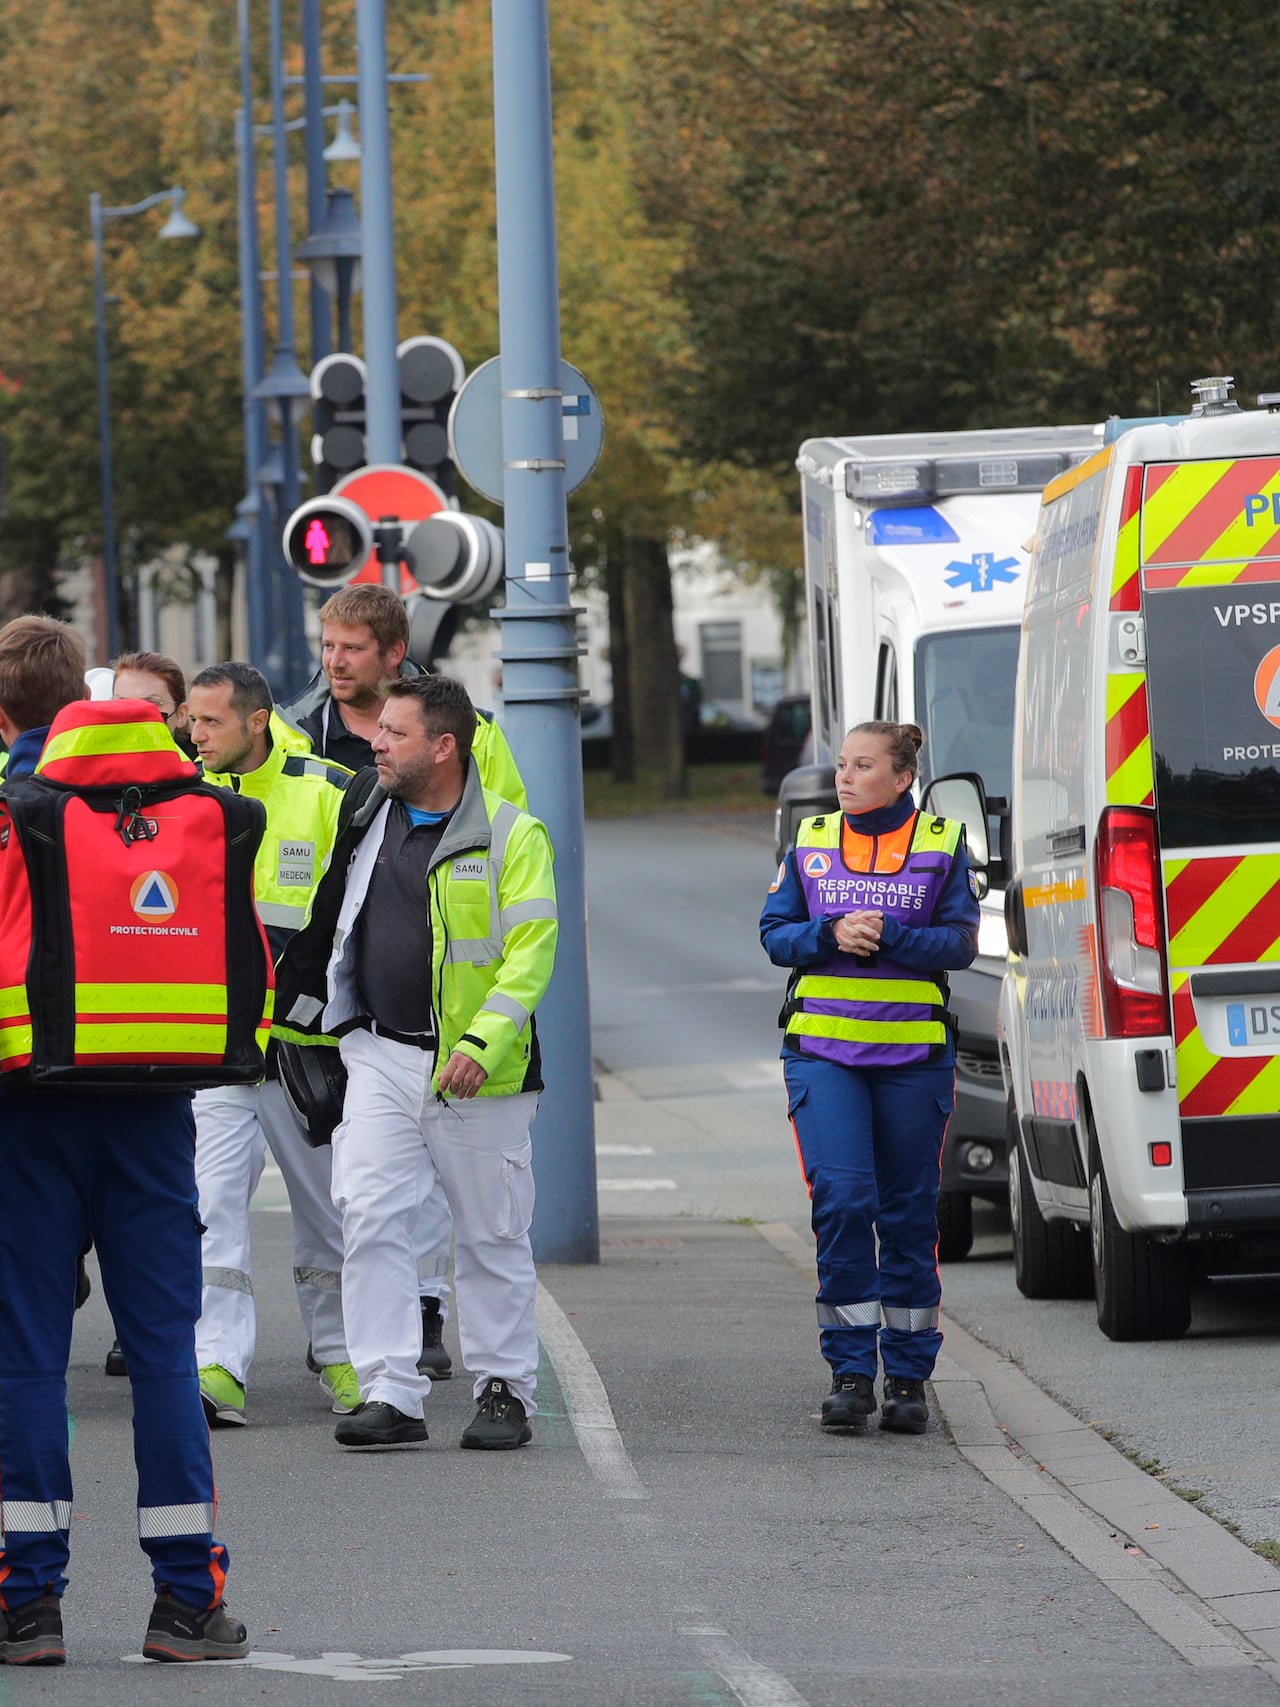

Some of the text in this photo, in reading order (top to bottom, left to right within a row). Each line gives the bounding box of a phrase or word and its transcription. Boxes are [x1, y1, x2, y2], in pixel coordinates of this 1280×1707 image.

[1223, 744, 1280, 761] PROTE
[282, 847, 311, 857] SAMU
[455, 864, 483, 874] SAMU
[279, 870, 311, 880] MEDECIN
[818, 879, 927, 898] RESPONSABLE
[819, 891, 923, 910] IMPLIQUES
[110, 926, 199, 936] PROTECTION CIVILE
